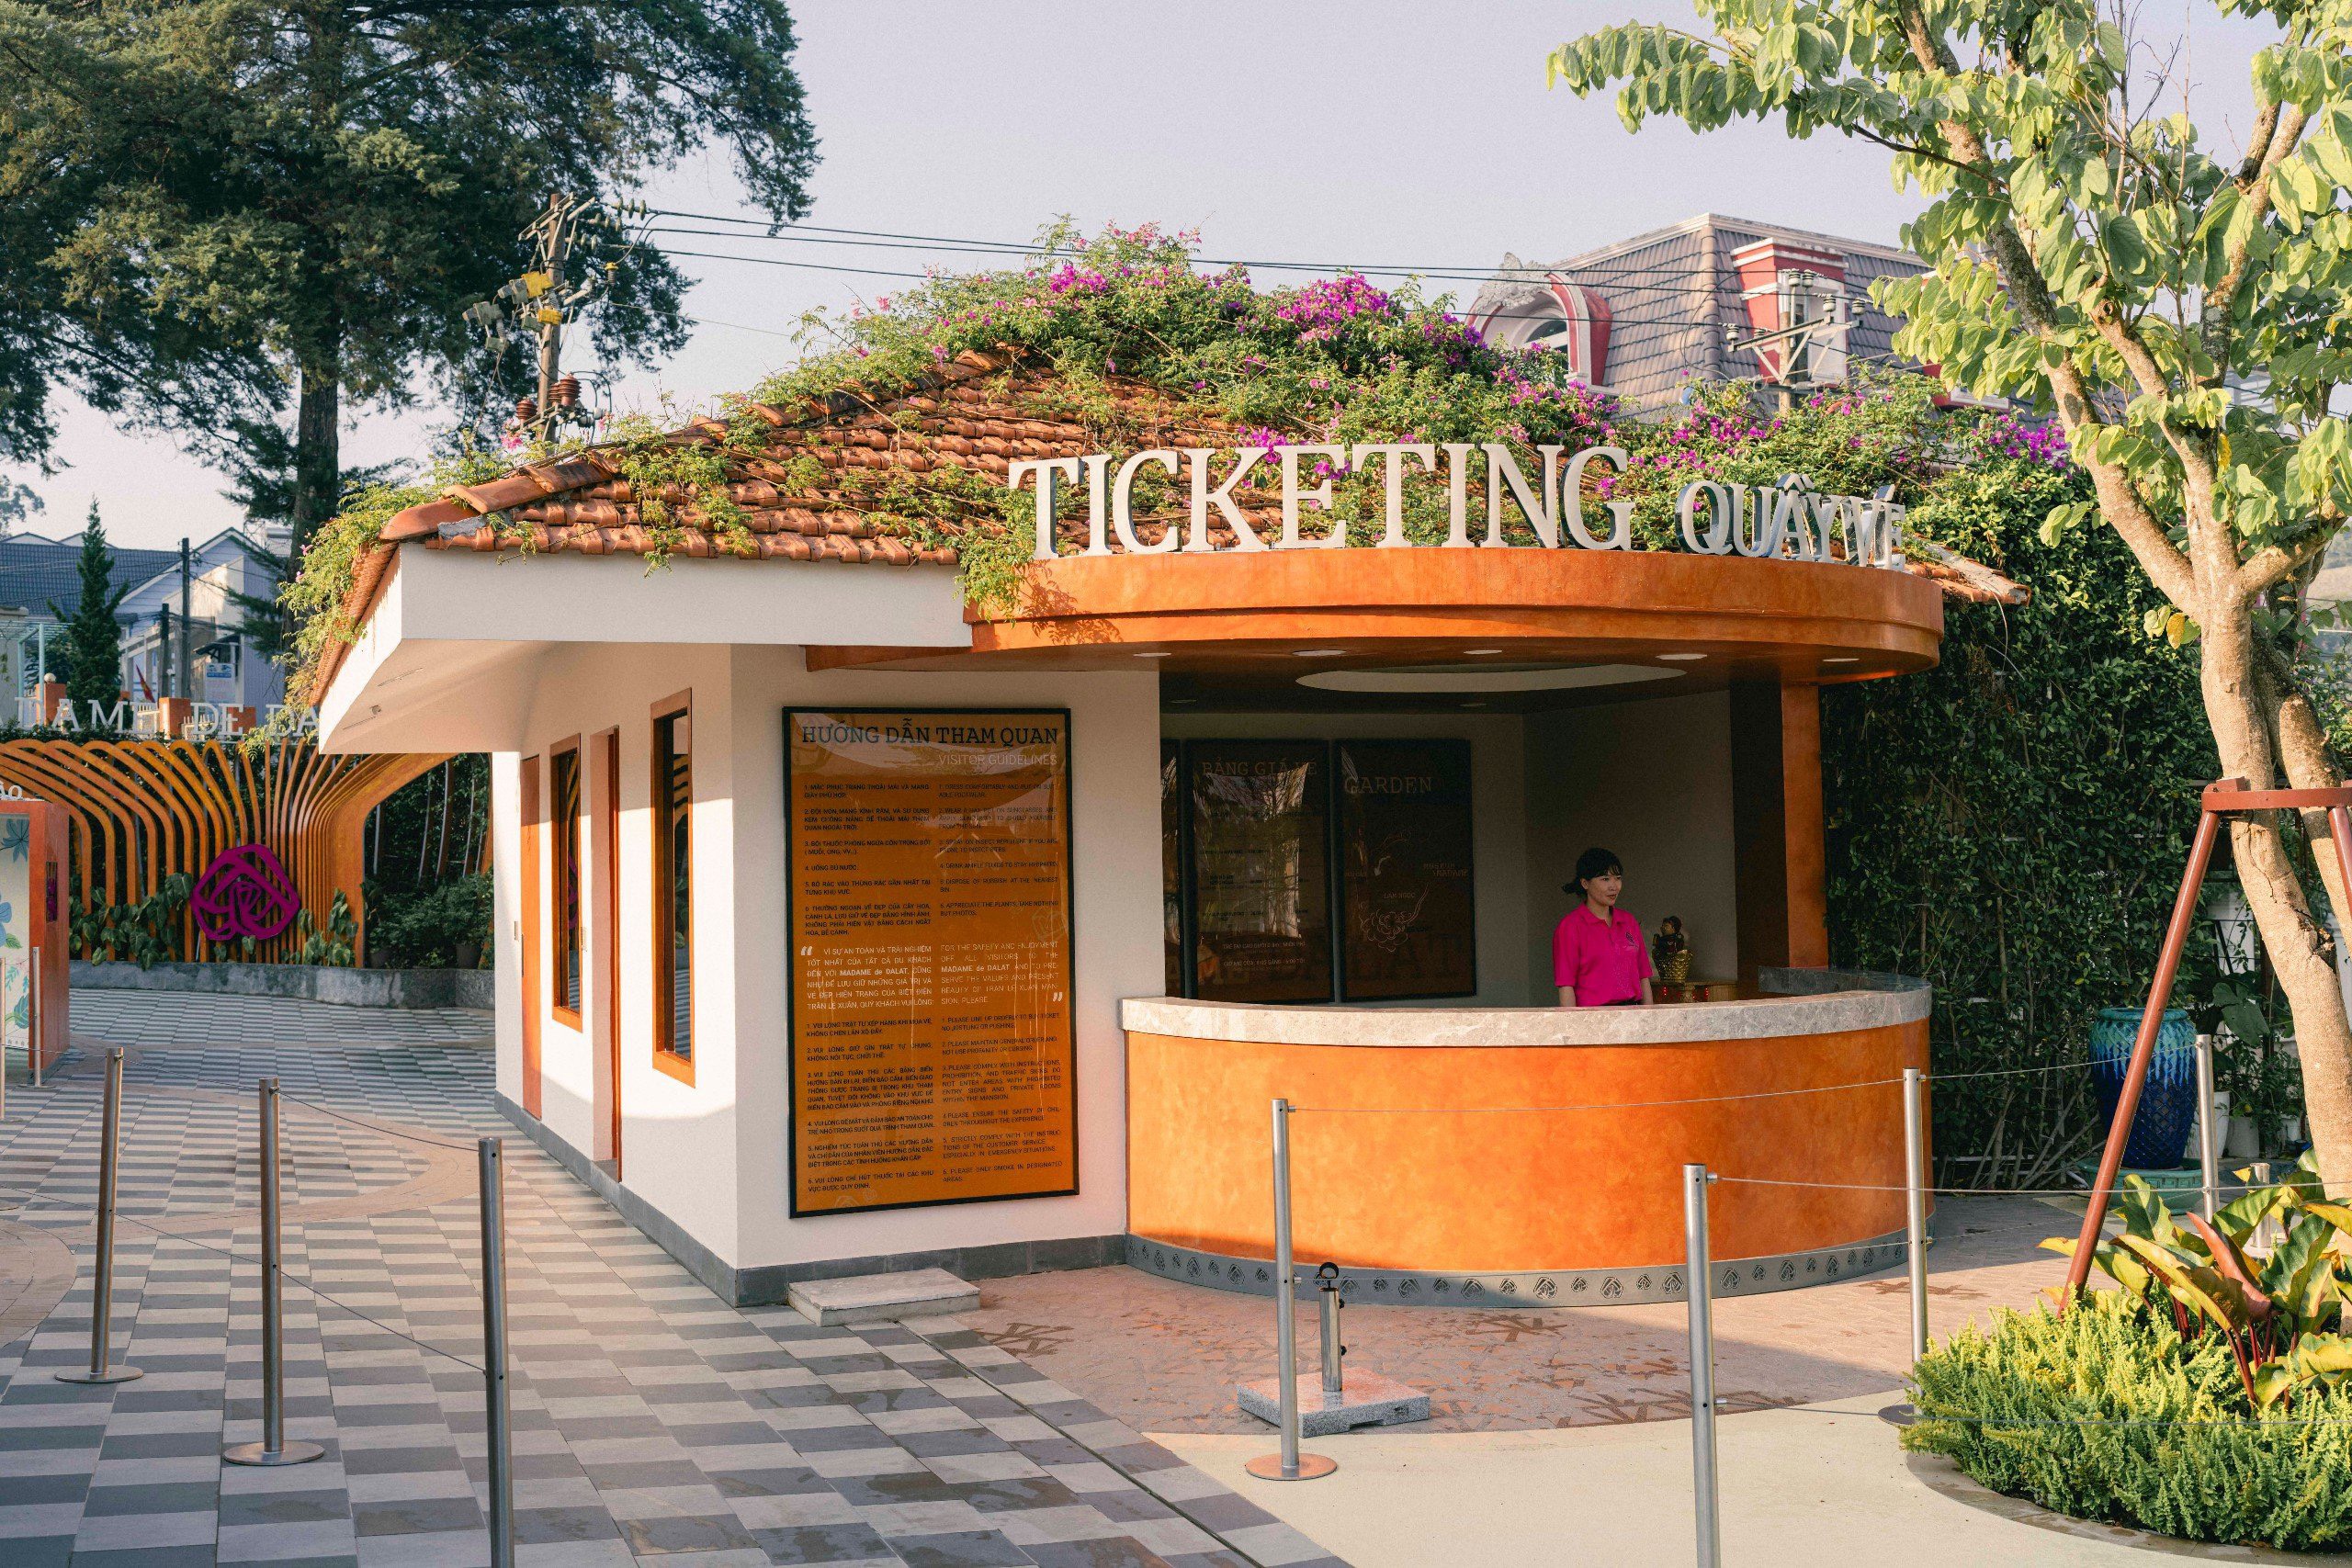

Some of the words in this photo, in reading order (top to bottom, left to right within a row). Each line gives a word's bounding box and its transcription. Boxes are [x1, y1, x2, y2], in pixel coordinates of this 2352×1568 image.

[1009, 443, 1636, 559] TICKETING
[1840, 484, 1906, 571] VÉ
[191, 703, 244, 735] DE
[802, 720, 880, 743] HƯỚNG
[885, 718, 930, 743] DẪN
[937, 728, 995, 743] THAM
[1000, 728, 1057, 746] QUAN
[939, 755, 984, 765] VISITOR
[989, 755, 1057, 766] GUIDELINES
[1202, 756, 1248, 775] BẢNG
[1344, 777, 1432, 794] GARDEN
[840, 968, 871, 976] MADAME
